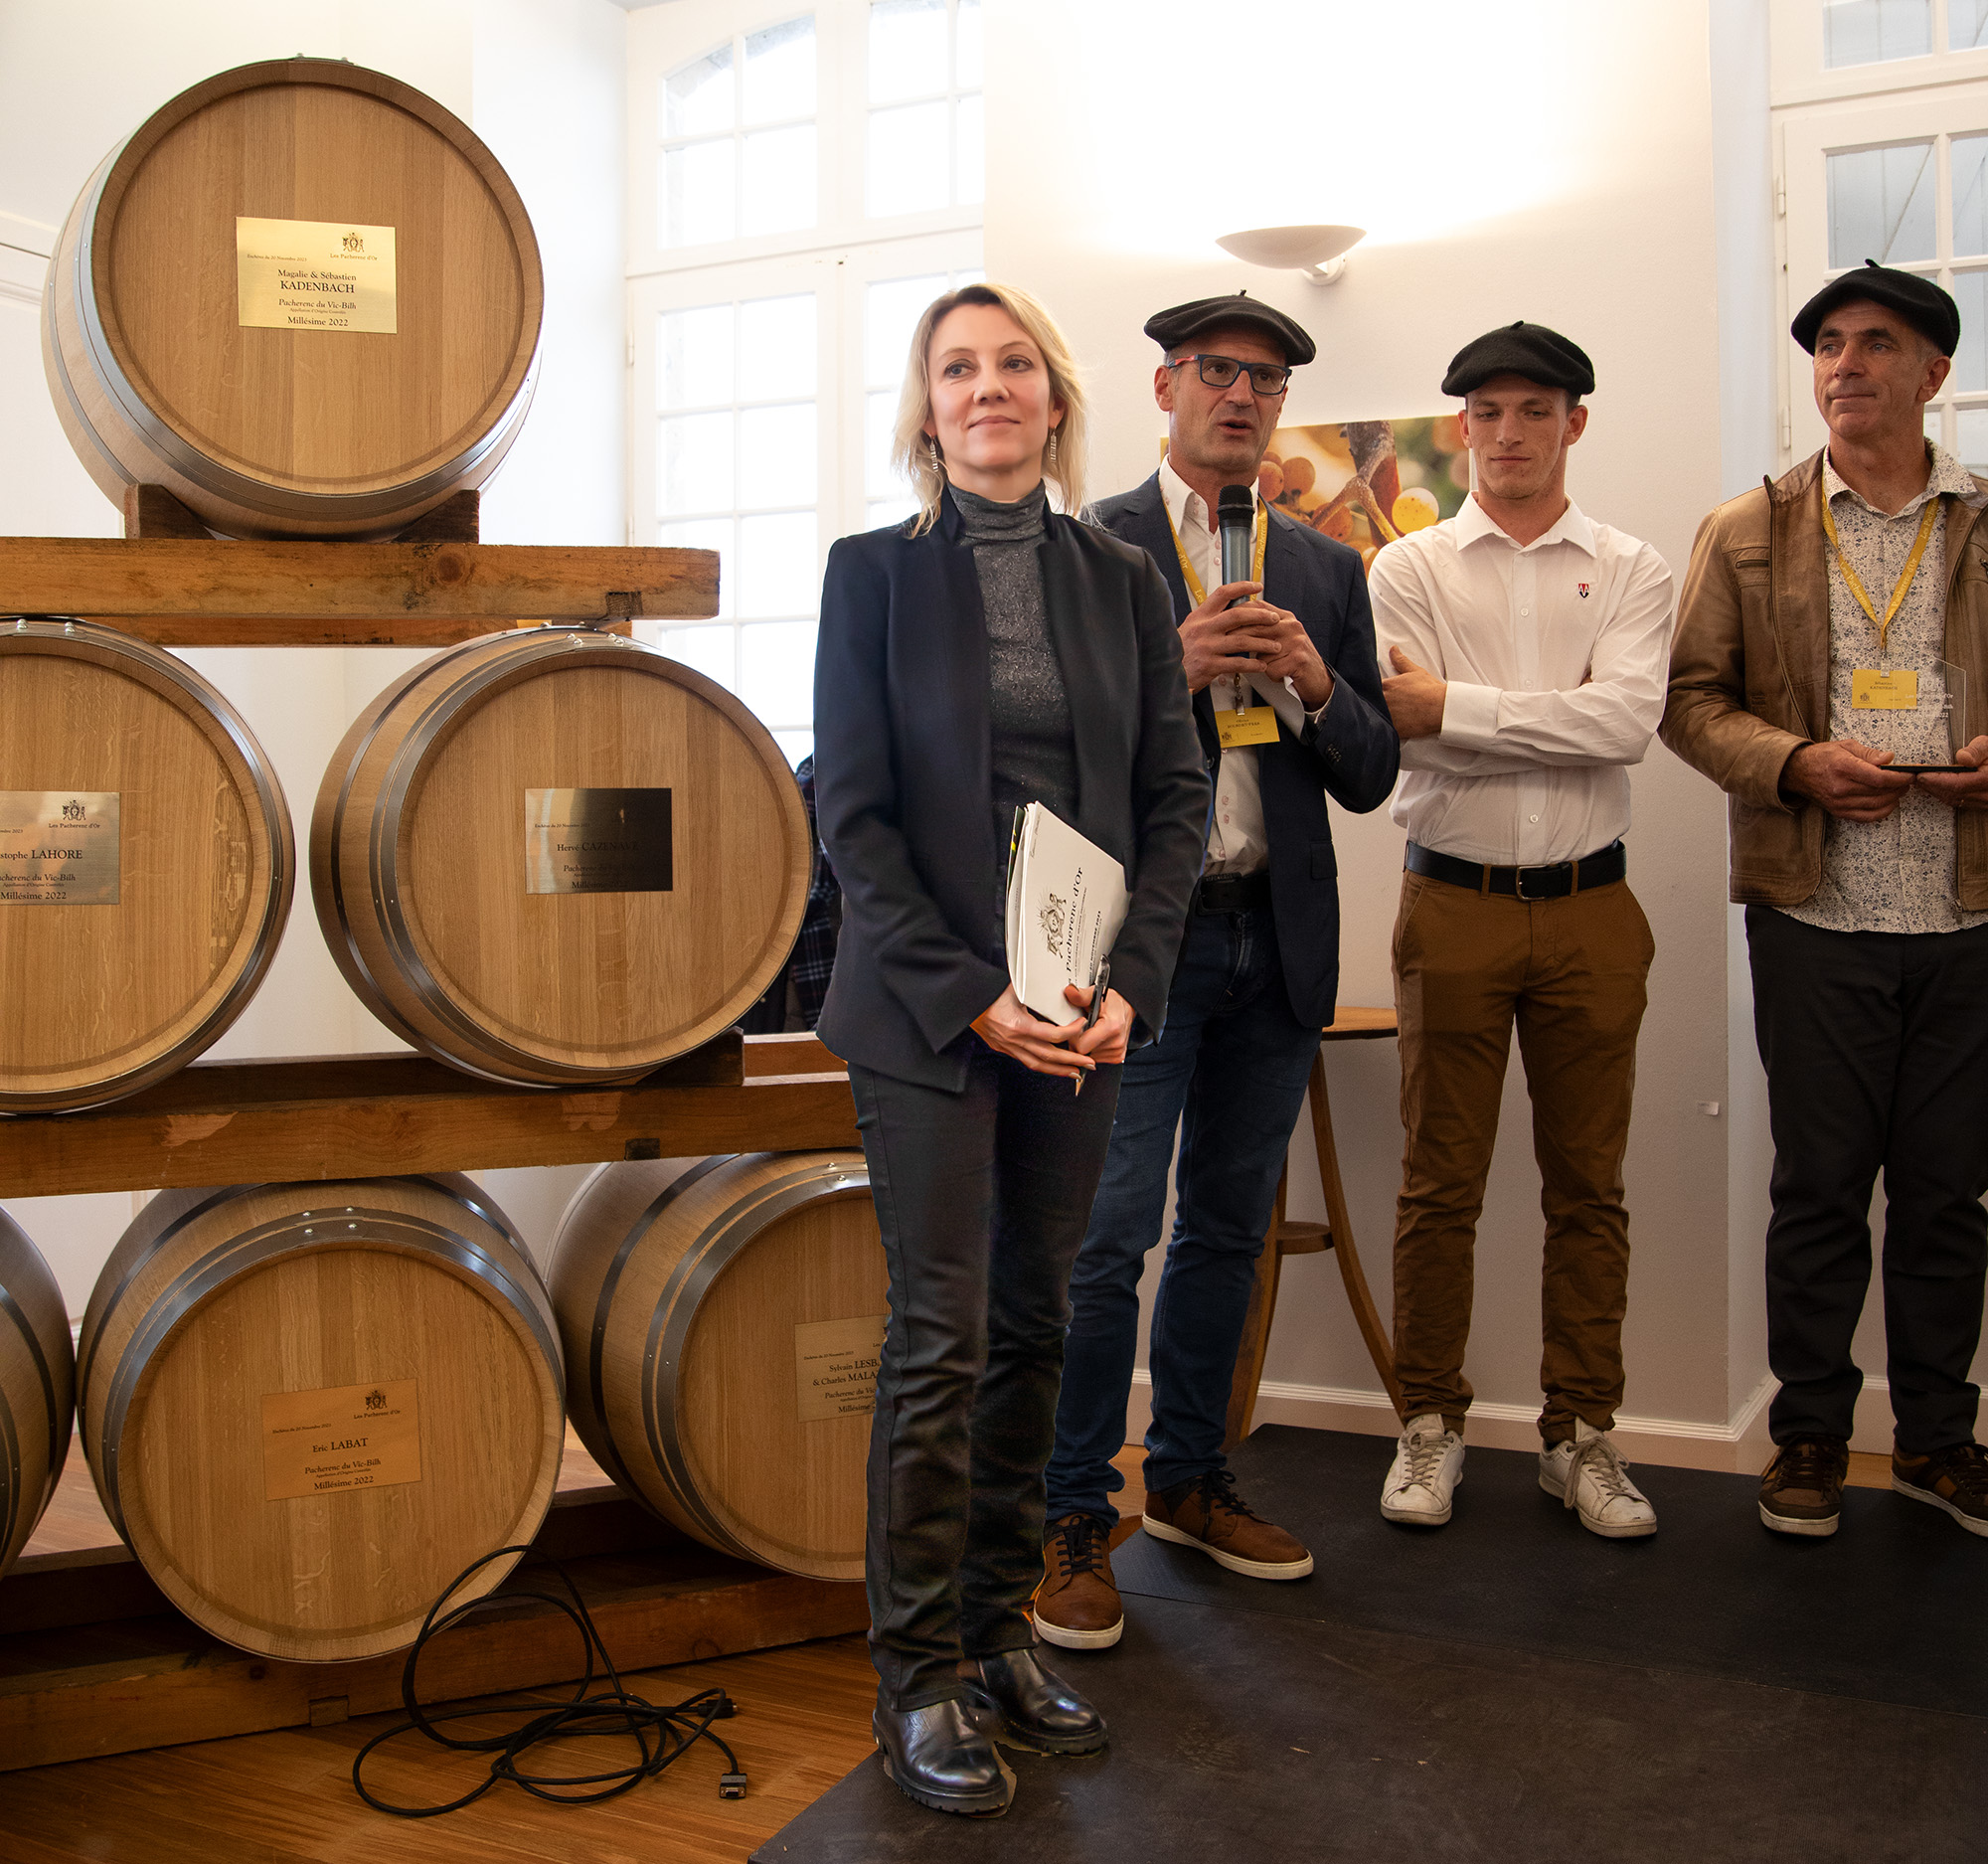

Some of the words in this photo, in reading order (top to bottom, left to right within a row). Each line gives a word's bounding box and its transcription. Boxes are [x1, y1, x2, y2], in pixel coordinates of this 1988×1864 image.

[278, 269, 308, 280] Magalie
[320, 271, 357, 281] Sébastien
[280, 280, 354, 293] KADENBACH
[278, 298, 314, 308] Pacherenc
[288, 316, 326, 326] Millésime
[32, 849, 83, 859] LAHORE
[1067, 901, 1077, 972] Pacherenc
[1074, 867, 1082, 897] d'Or
[825, 1390, 855, 1399] Pacherenc
[331, 1438, 368, 1450] LABAT
[305, 1464, 340, 1474] Pacherenc
[352, 1458, 381, 1467] Vic-Bilh
[314, 1479, 352, 1490] Millésime
[354, 1475, 374, 1485] 2022
